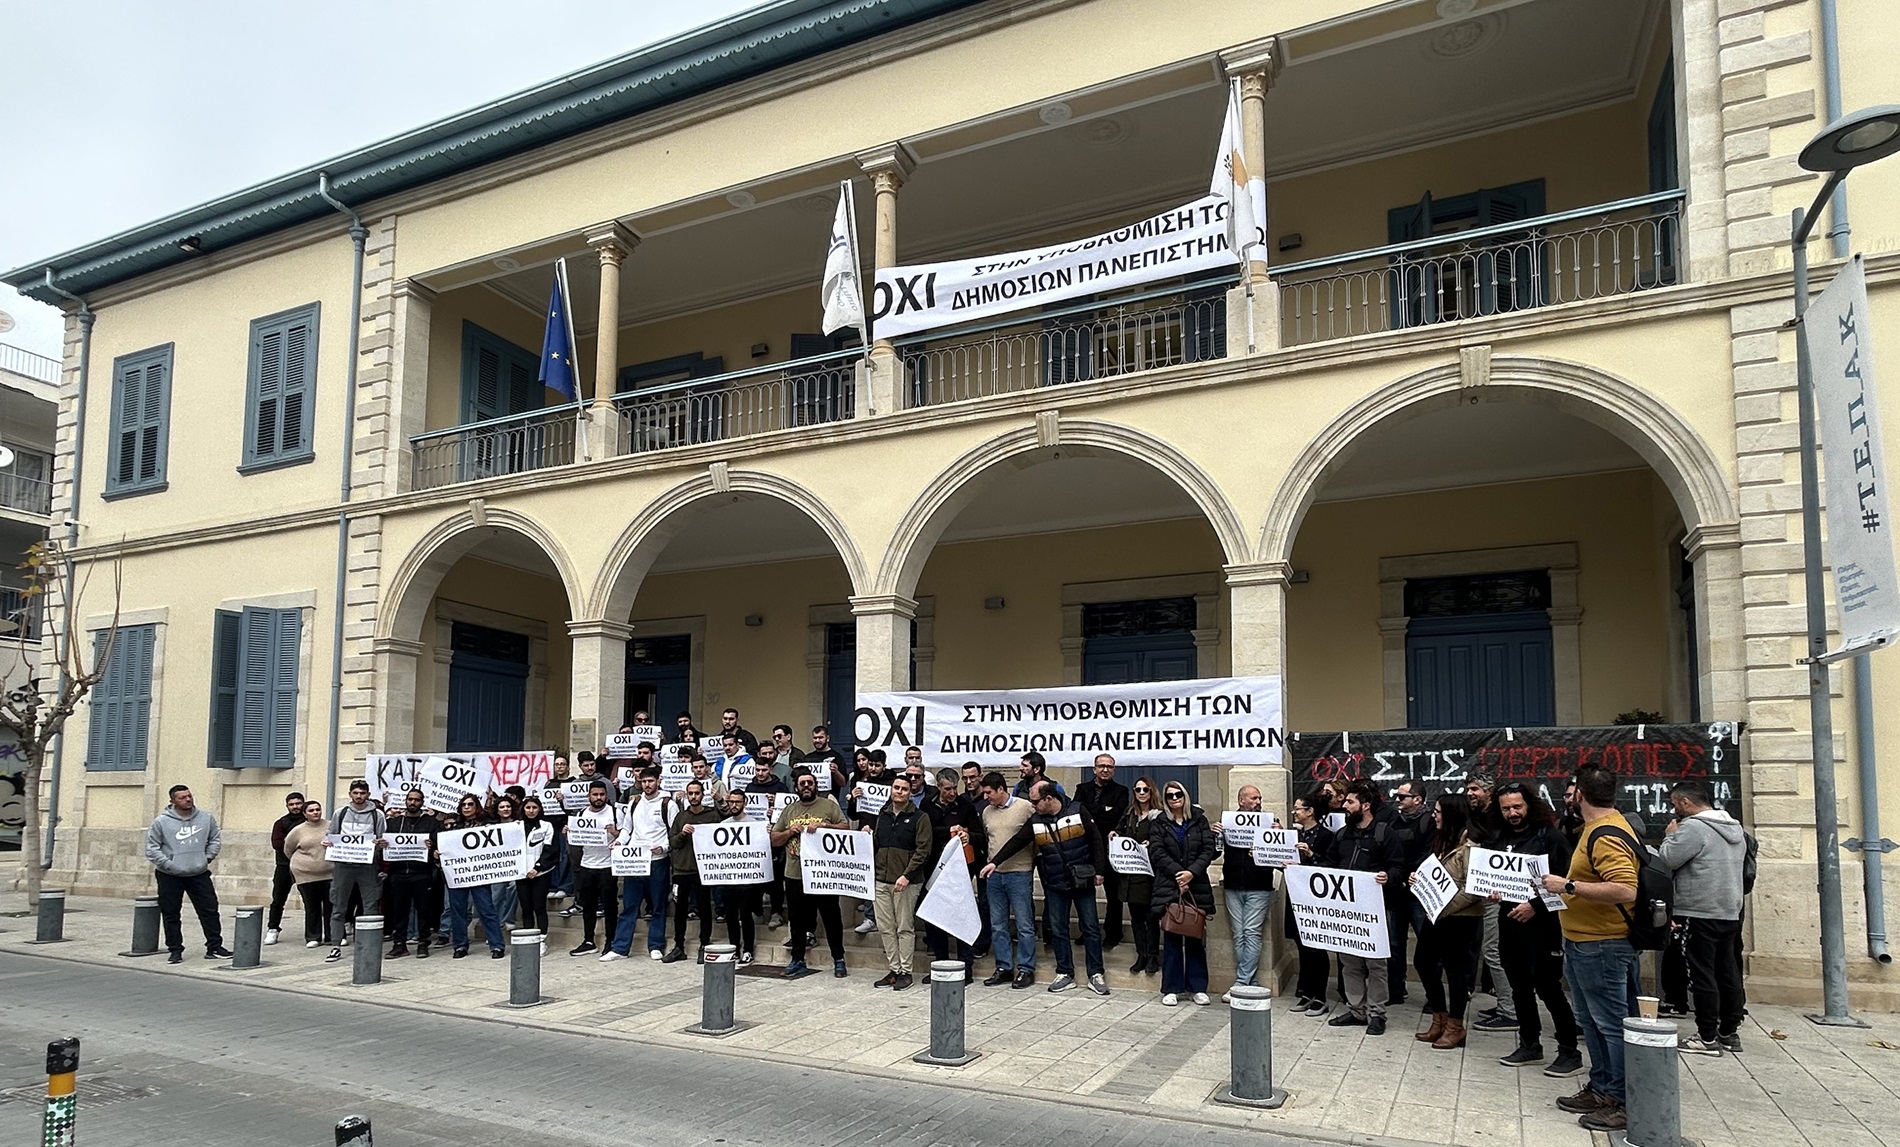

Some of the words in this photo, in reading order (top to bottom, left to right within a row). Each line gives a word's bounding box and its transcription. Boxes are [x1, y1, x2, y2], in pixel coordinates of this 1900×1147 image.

[972, 258, 1031, 277] ΣΤΗΝ
[1199, 200, 1230, 225] ΤΩ
[872, 272, 937, 322] ΟΧΙ
[951, 267, 1072, 312] ΔΗΜΟΣΙΩΝ
[963, 703, 1022, 723] ΣΤΗΝ
[1027, 697, 1191, 721] ΥΠΟΒΑΘΜΙΣΗ
[1197, 694, 1252, 716] ΤΩΝ
[636, 726, 653, 736] ΟΧΙ
[854, 706, 925, 747] ΟΧΙ
[613, 735, 631, 745] ΟΧΙ
[940, 733, 1064, 753] ΔΗΜΟΣΙΩΝ
[1071, 727, 1283, 751] ΠΑΝΕΠΙΣΤΗΜΙΩΝ
[488, 754, 552, 787] ΧΕΡΙΑ
[670, 764, 688, 774] ΟΧΙ
[1311, 752, 1366, 781] ΟΧΙ
[1370, 748, 1469, 781] ΣΤΙΣ
[441, 764, 476, 787] ΟΧΙ
[570, 784, 588, 794] ΟΧΙ
[868, 785, 889, 797] ΟΧΙ
[577, 818, 597, 829] ΟΧΙ
[1235, 814, 1260, 827] ΟΧΙ
[341, 835, 364, 845] ΟΧΙ
[395, 835, 418, 845] ΟΧΙ
[461, 828, 504, 850] ΟΧΙ
[713, 826, 750, 847] ΟΧΙ
[822, 833, 855, 855] ΟΧΙ
[1263, 830, 1286, 844] ΟΧΙ
[444, 857, 467, 866] ΣΤΗΝ
[468, 849, 522, 863] ΥΠΟΒΑΘΜΙΣΗ
[622, 847, 642, 858] ΟΧΙ
[697, 852, 717, 861] ΣΤΗΝ
[717, 850, 767, 860] ΥΠΟΒΑΘΜΙΣΗ
[454, 865, 471, 875] ΤΩΝ
[472, 860, 517, 872] ΔΗΜΟΣΙΩΝ
[704, 863, 719, 871] ΤΩΝ
[720, 861, 761, 870] ΔΗΜΟΣΙΩΝ
[803, 859, 827, 868] ΣΤΗΝ
[827, 859, 871, 872] ΥΠΟΒΑΘΜΙΣΗ
[1489, 854, 1523, 873] ΟΧΙ
[454, 869, 519, 884] ΠΑΝΕΠΙΣΤΗΜΙΩΝ
[703, 871, 765, 881] ΠΑΝΕΠΙΣΤΗΜΙΩΝ
[812, 870, 830, 879] ΤΩΝ
[830, 871, 866, 883] ΔΗΜΟΣΙΩΝ
[1431, 866, 1451, 893] ΟΧΙ
[1470, 868, 1489, 877] ΣΤΗΝ
[1490, 873, 1532, 884] ΥΠΟΒΑΘΜΙΣ
[810, 882, 868, 894] ΠΑΝΕΠΙΣΤΗΜΙΩΝ
[1309, 872, 1356, 903] ΟΧΙ
[1475, 878, 1491, 886] ΤΩΝ
[1491, 882, 1529, 893] ΔΗΜΟΣΙΩΝ
[1292, 903, 1314, 915] ΣΤΗΝ
[1315, 905, 1379, 924] ΥΠΟΒΑΘΜΙΣΗ
[1299, 917, 1319, 929] ΤΩΝ
[1320, 920, 1370, 937] ΔΗΜΟΣΙΩΝ
[1300, 930, 1376, 952] ΠΑΝΕΠΙΣΤΗΜΙΩΝ
